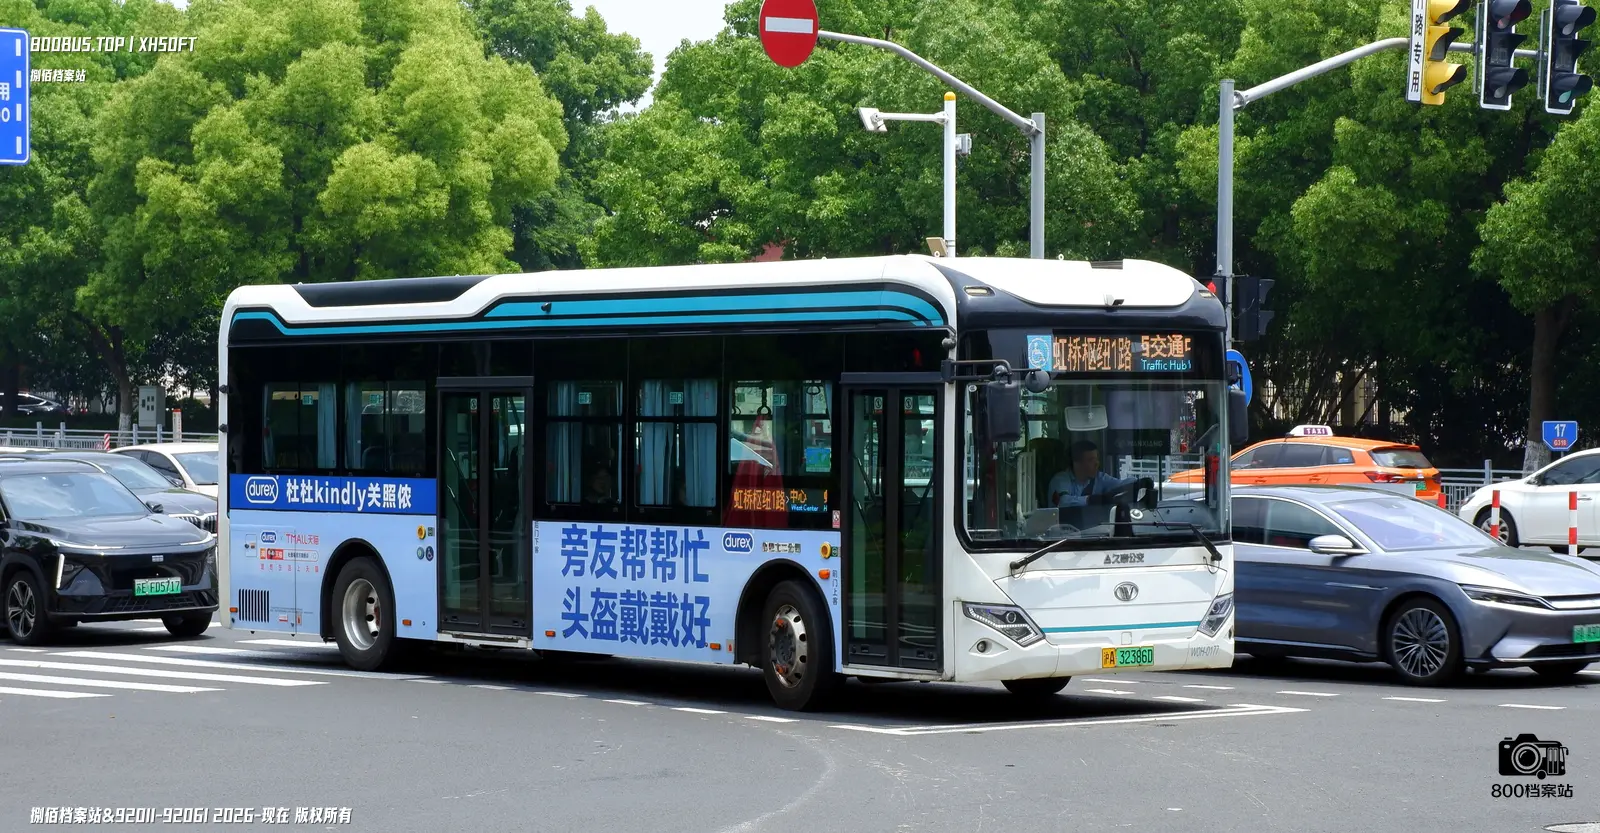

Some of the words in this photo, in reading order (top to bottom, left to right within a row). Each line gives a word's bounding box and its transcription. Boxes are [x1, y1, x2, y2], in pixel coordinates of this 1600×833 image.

[1053, 336, 1132, 371] 虹桥枢纽1路
[1141, 359, 1168, 370] Traffic
[1170, 359, 1187, 370] Hub
[1306, 427, 1327, 435] TAXI
[1554, 423, 1566, 438] 17
[248, 479, 276, 498] durex
[286, 478, 412, 511] 杜杜kindly关照侬
[733, 488, 786, 511] 虹桥枢纽1路
[725, 533, 753, 550] durex
[561, 523, 710, 583] 旁友帮帮忙
[561, 586, 711, 649] 头盔戴戴好
[1119, 648, 1153, 665] 32386D
